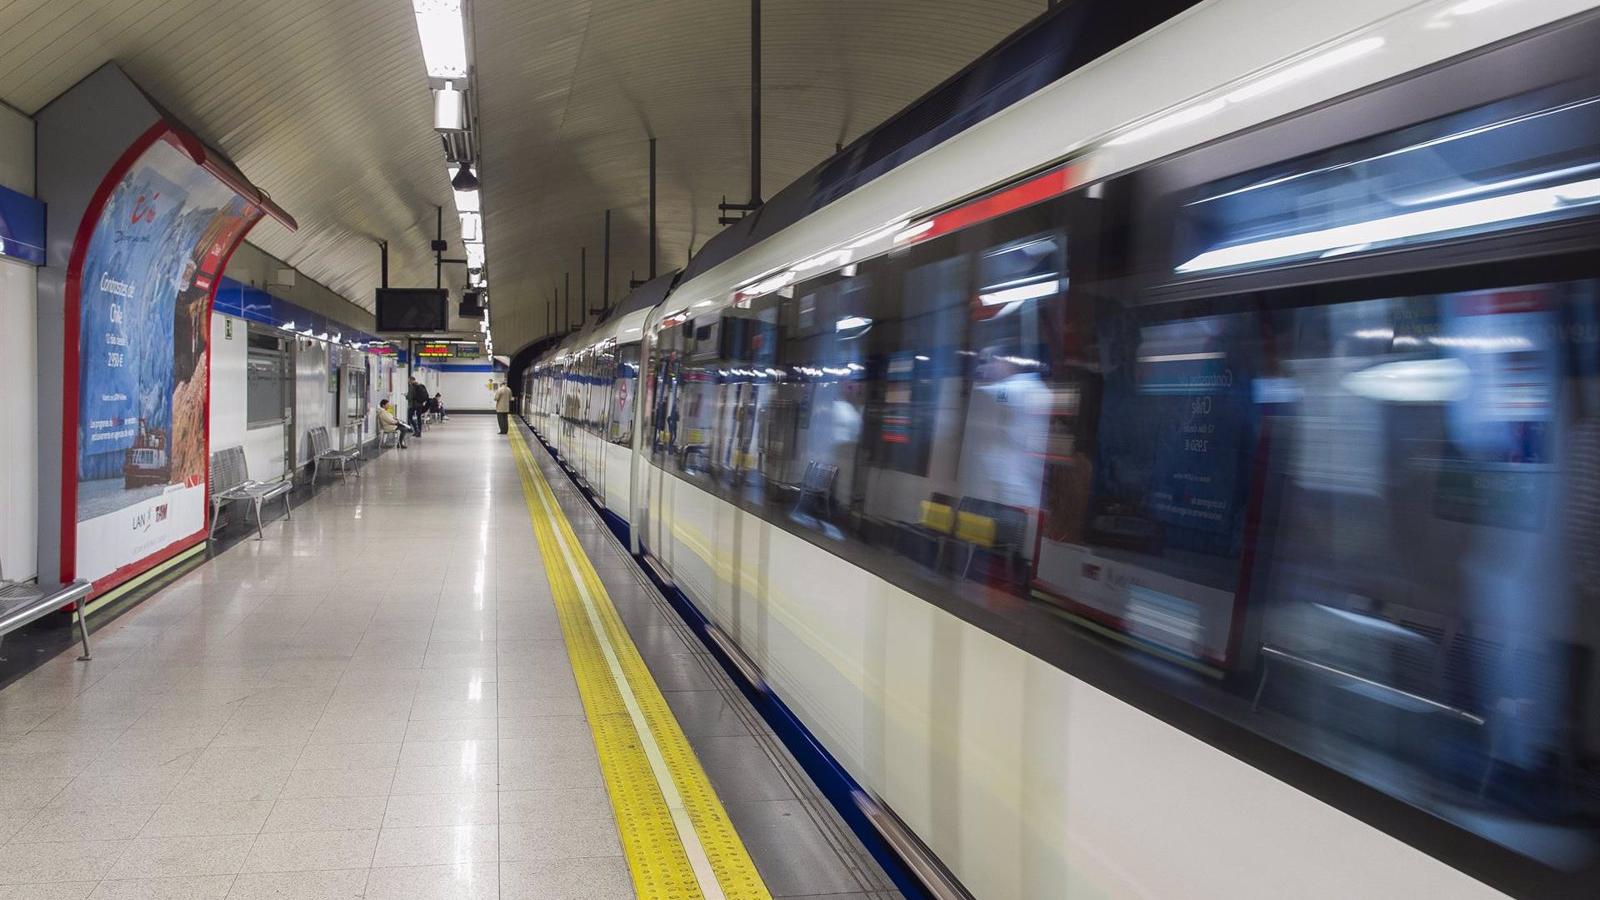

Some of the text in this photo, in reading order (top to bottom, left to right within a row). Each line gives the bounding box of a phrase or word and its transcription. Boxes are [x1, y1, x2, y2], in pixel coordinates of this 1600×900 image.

[100, 271, 128, 297] Contrastes
[110, 302, 122, 325] Chile
[132, 511, 146, 530] LAN
